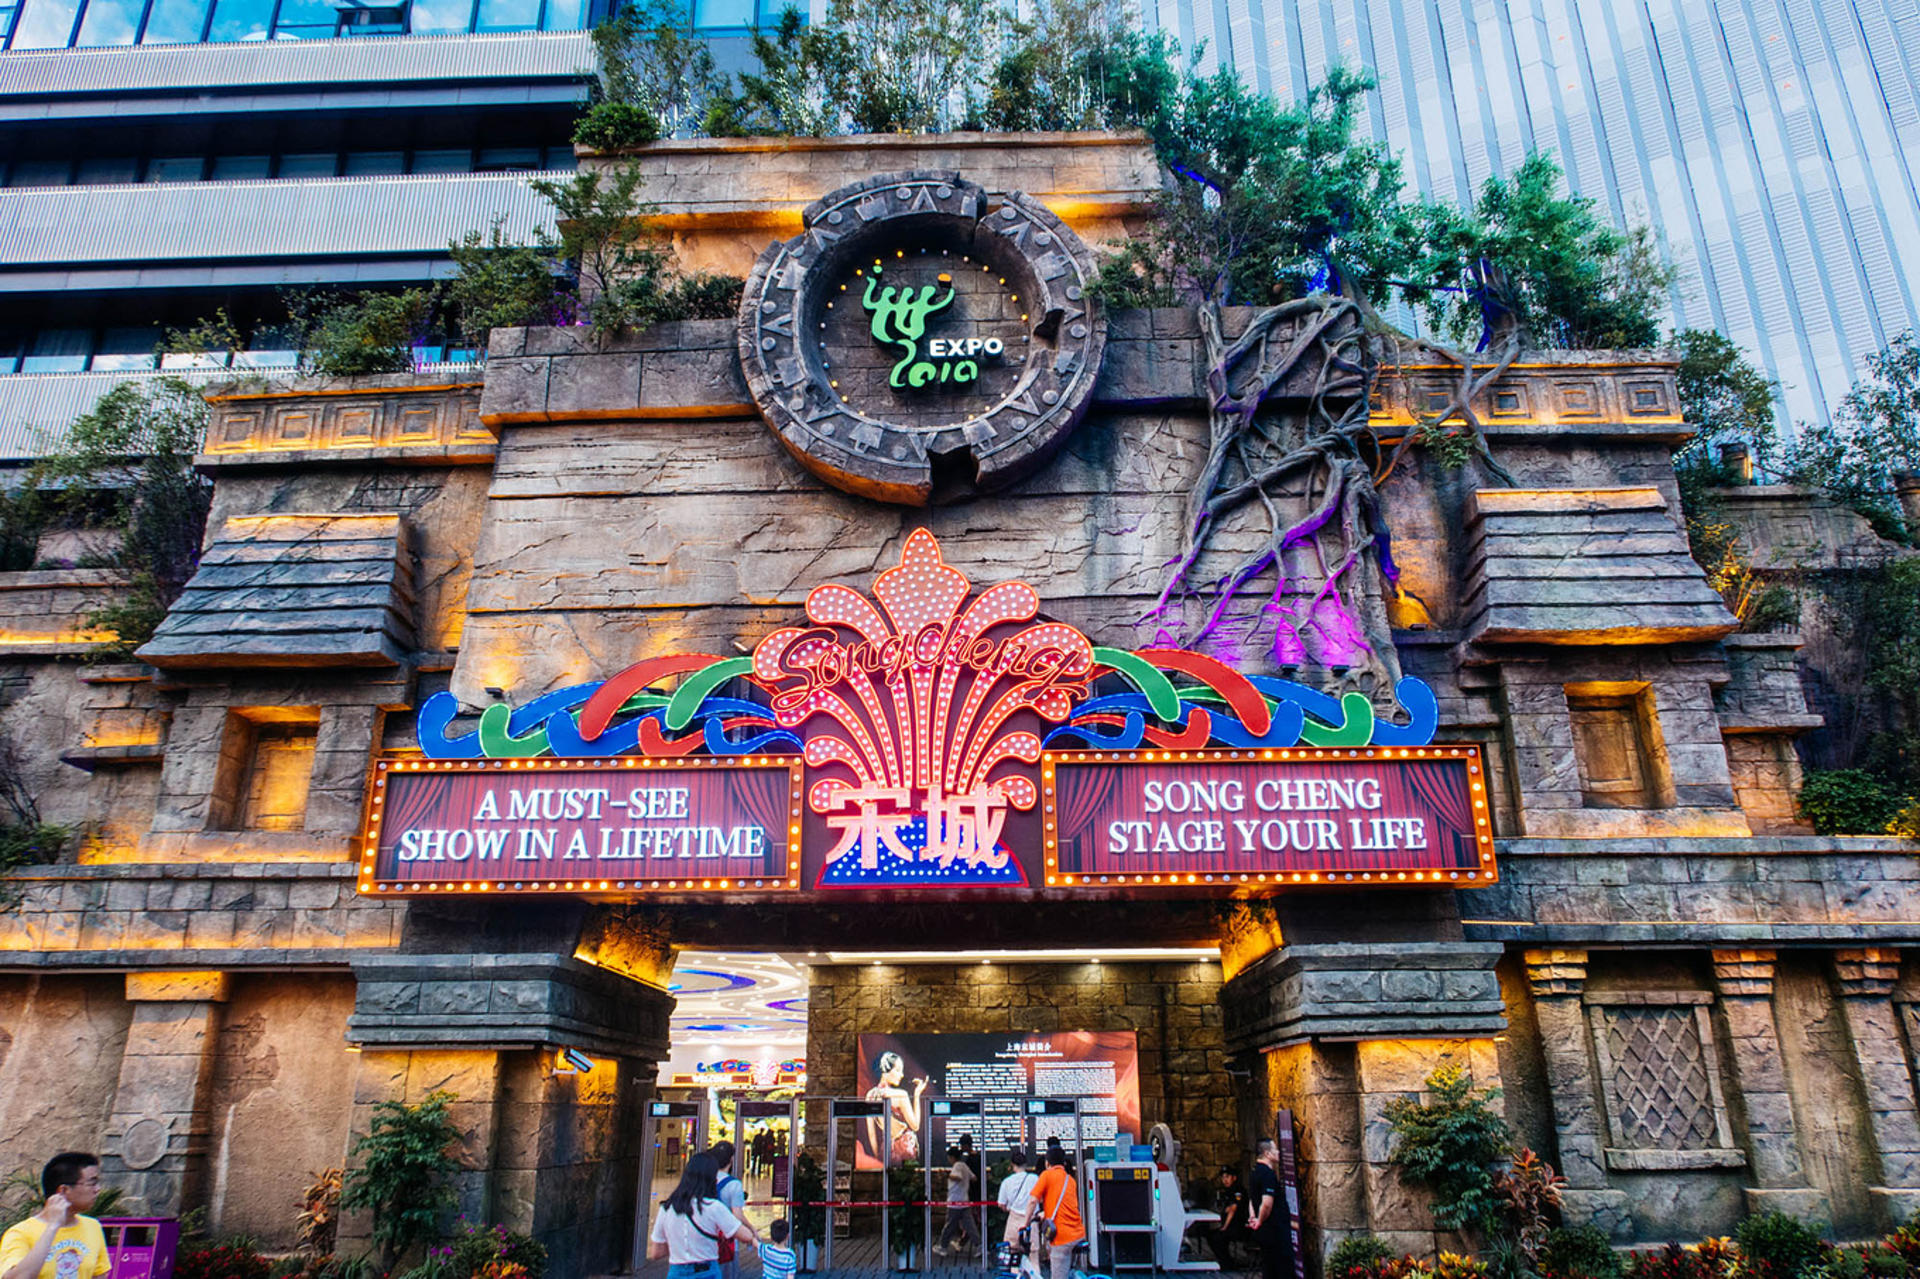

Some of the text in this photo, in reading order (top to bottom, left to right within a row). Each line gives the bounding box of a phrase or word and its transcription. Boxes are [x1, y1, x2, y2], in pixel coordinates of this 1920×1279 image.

[929, 337, 1004, 357] EXPO
[473, 787, 689, 820] A MUST-SEE
[1143, 778, 1383, 813] SONG CHENG
[826, 780, 1010, 870] 宋城
[1108, 817, 1428, 854] STAGE YOUR LIFE
[398, 826, 765, 861] SHOW IN A LIFETIME
